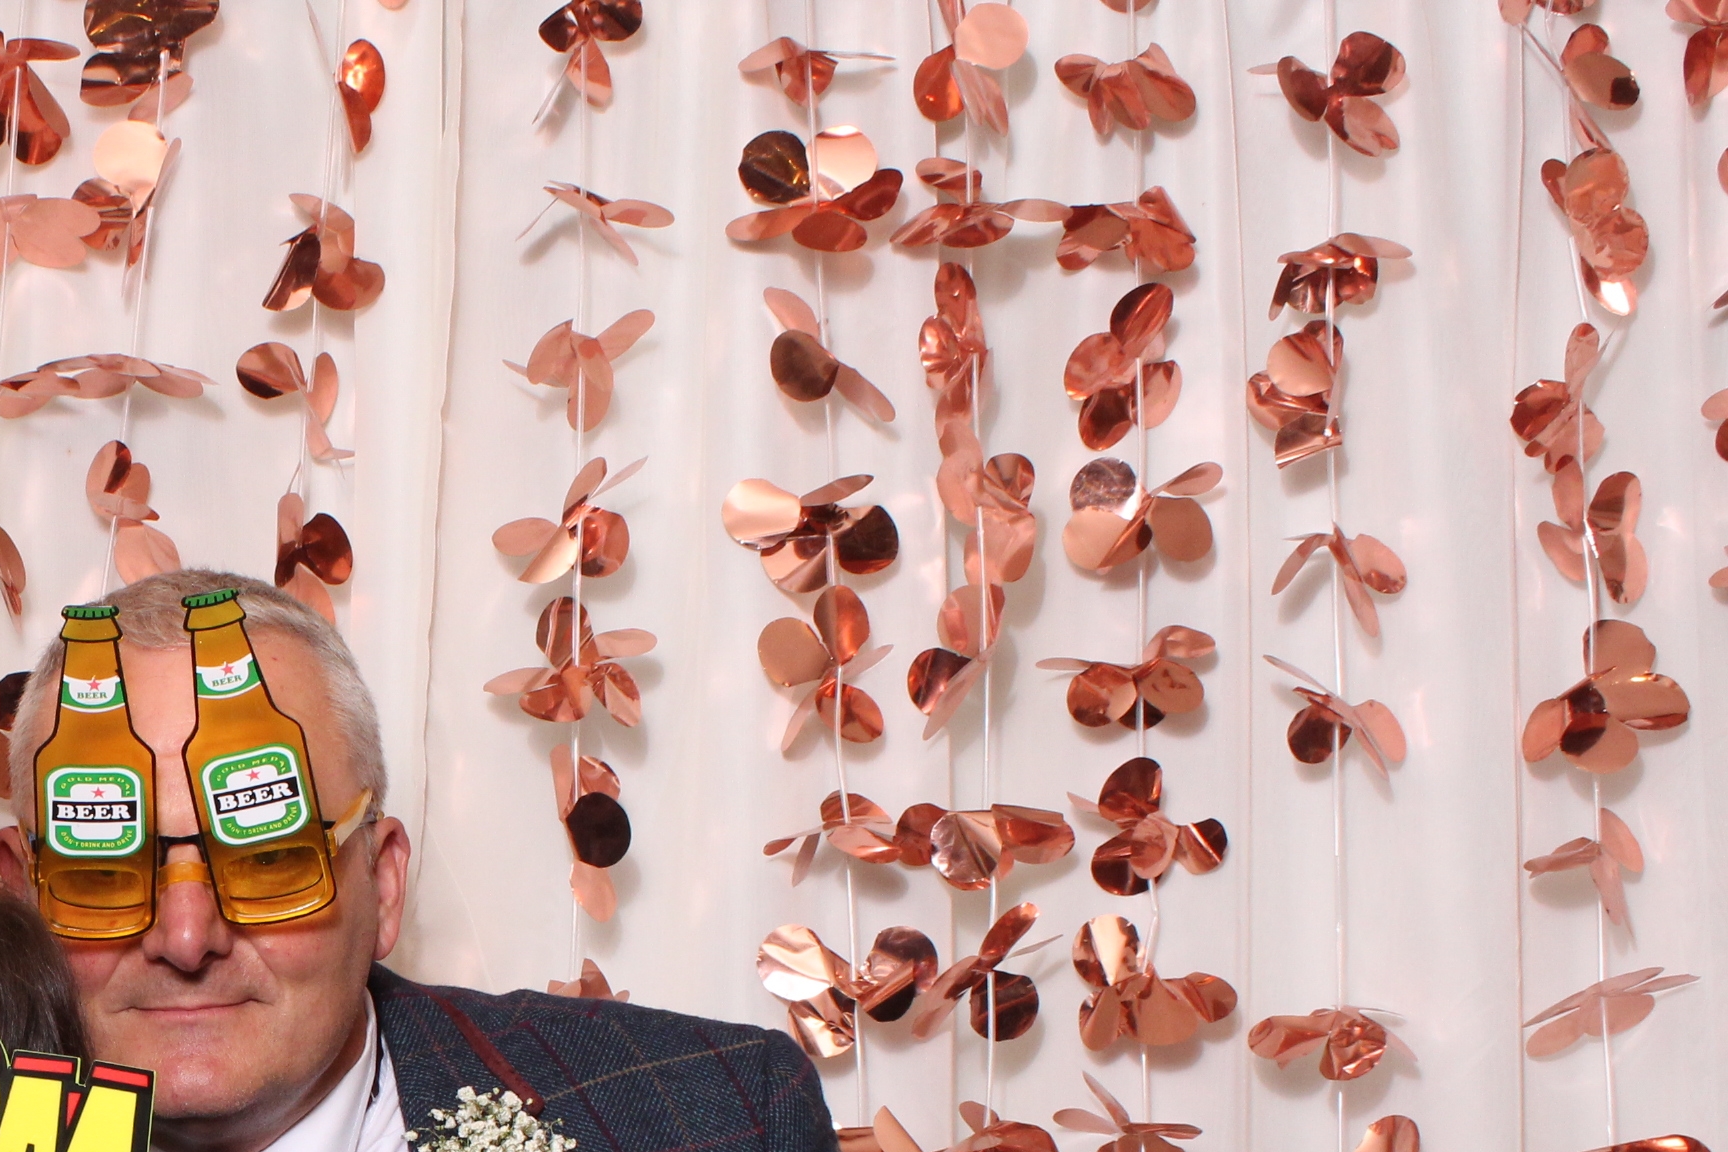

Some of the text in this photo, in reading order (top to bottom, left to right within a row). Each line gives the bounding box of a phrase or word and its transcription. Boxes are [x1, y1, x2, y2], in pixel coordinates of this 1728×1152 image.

[211, 674, 243, 688] BEER
[76, 691, 108, 700] BEER
[216, 756, 287, 781] GOLD MEDAL
[60, 776, 131, 796] GOLD MEDAL
[217, 782, 293, 812] BEER
[56, 804, 132, 820] BEER
[247, 826, 268, 835] DRINK
[268, 822, 283, 832] AND
[283, 805, 298, 825] DRIVE
[116, 830, 133, 847] DRIVE
